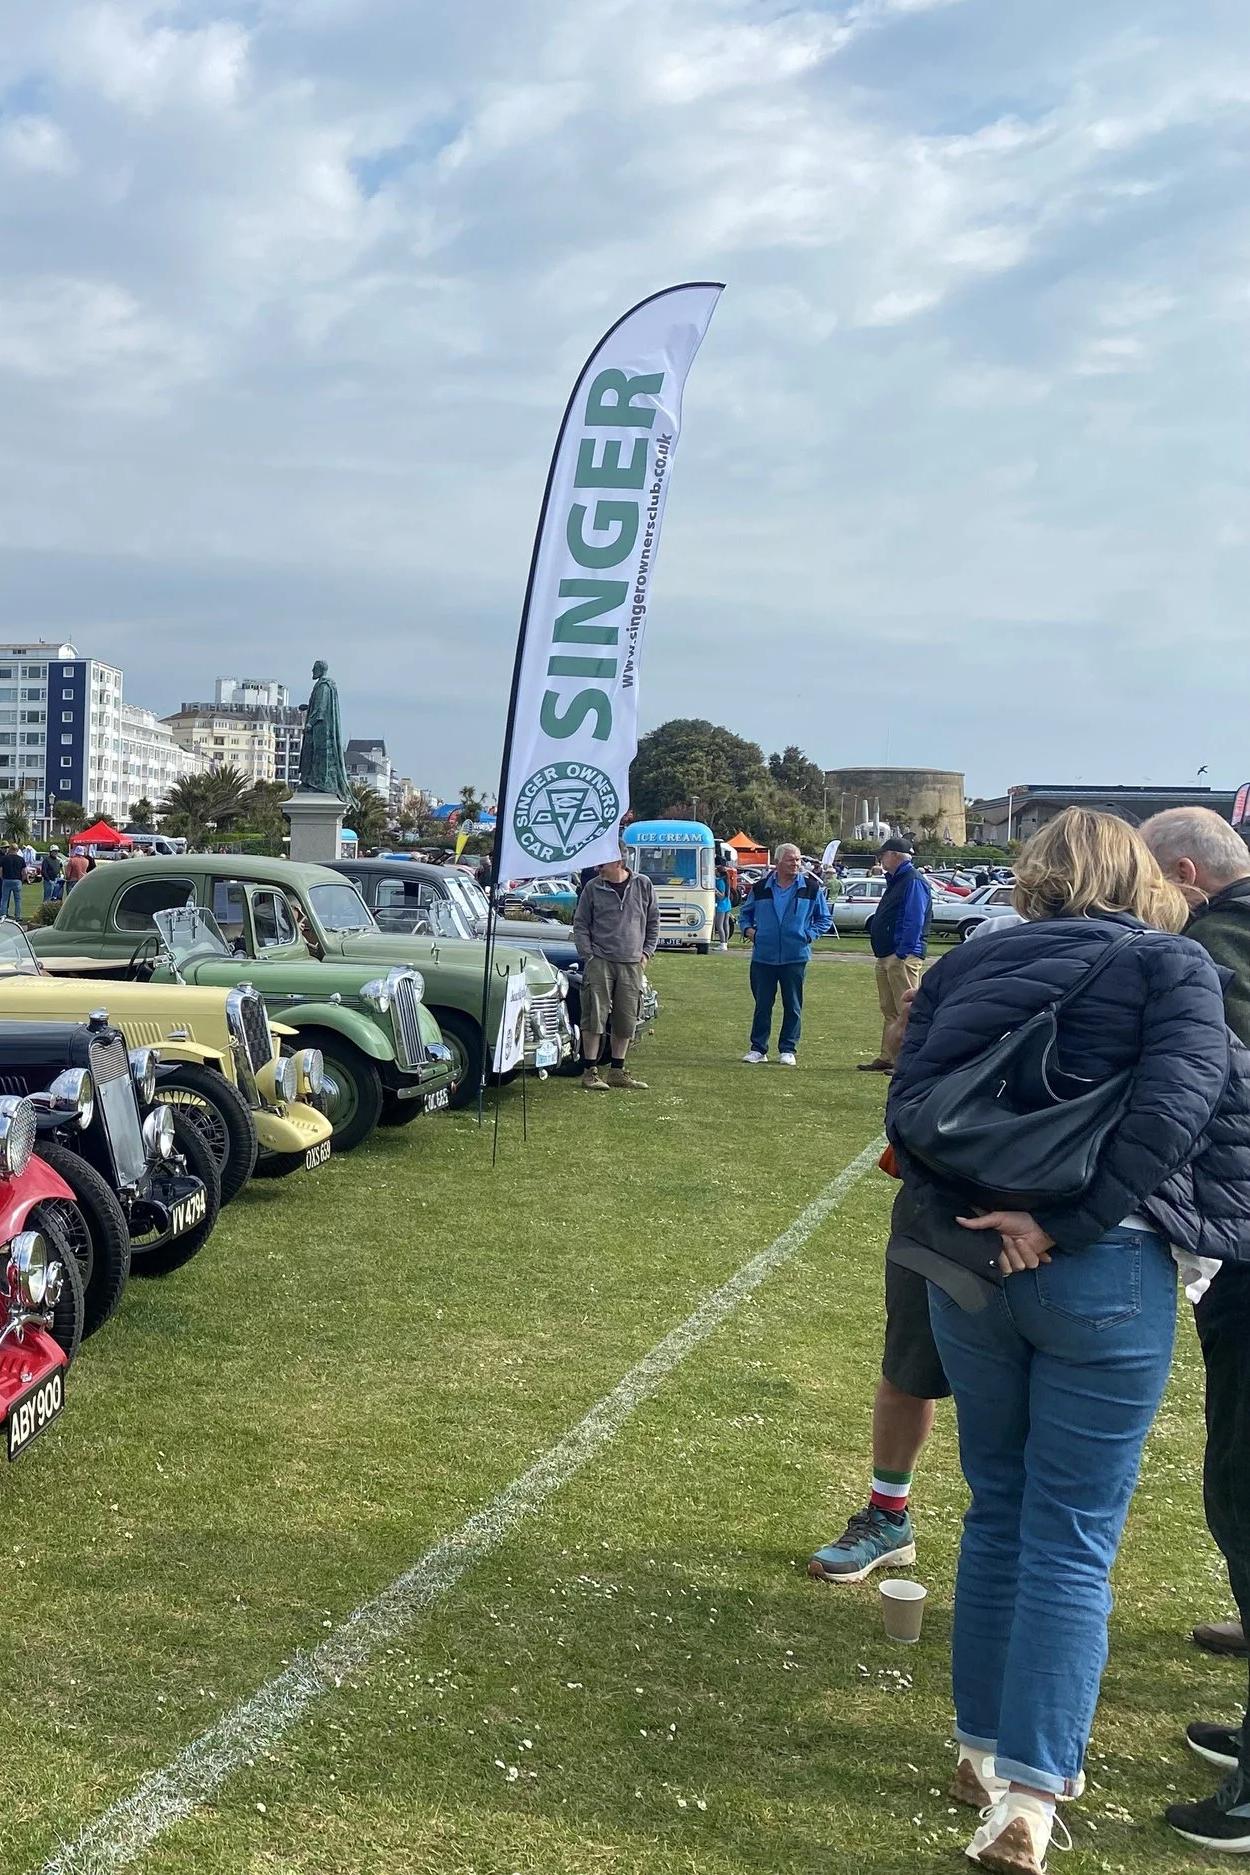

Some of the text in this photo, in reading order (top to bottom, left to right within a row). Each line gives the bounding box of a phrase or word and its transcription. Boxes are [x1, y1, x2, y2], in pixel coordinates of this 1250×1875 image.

[540, 368, 665, 741] SINGER
[622, 433, 672, 689] www.singerownersclub.co.uk
[516, 767, 559, 827] SINGER
[521, 832, 554, 860] CAR
[637, 833, 703, 842] ICE CREAM
[306, 1146, 320, 1170] OXS
[185, 1189, 206, 1225] 4794
[10, 1374, 61, 1453] ABY 900
